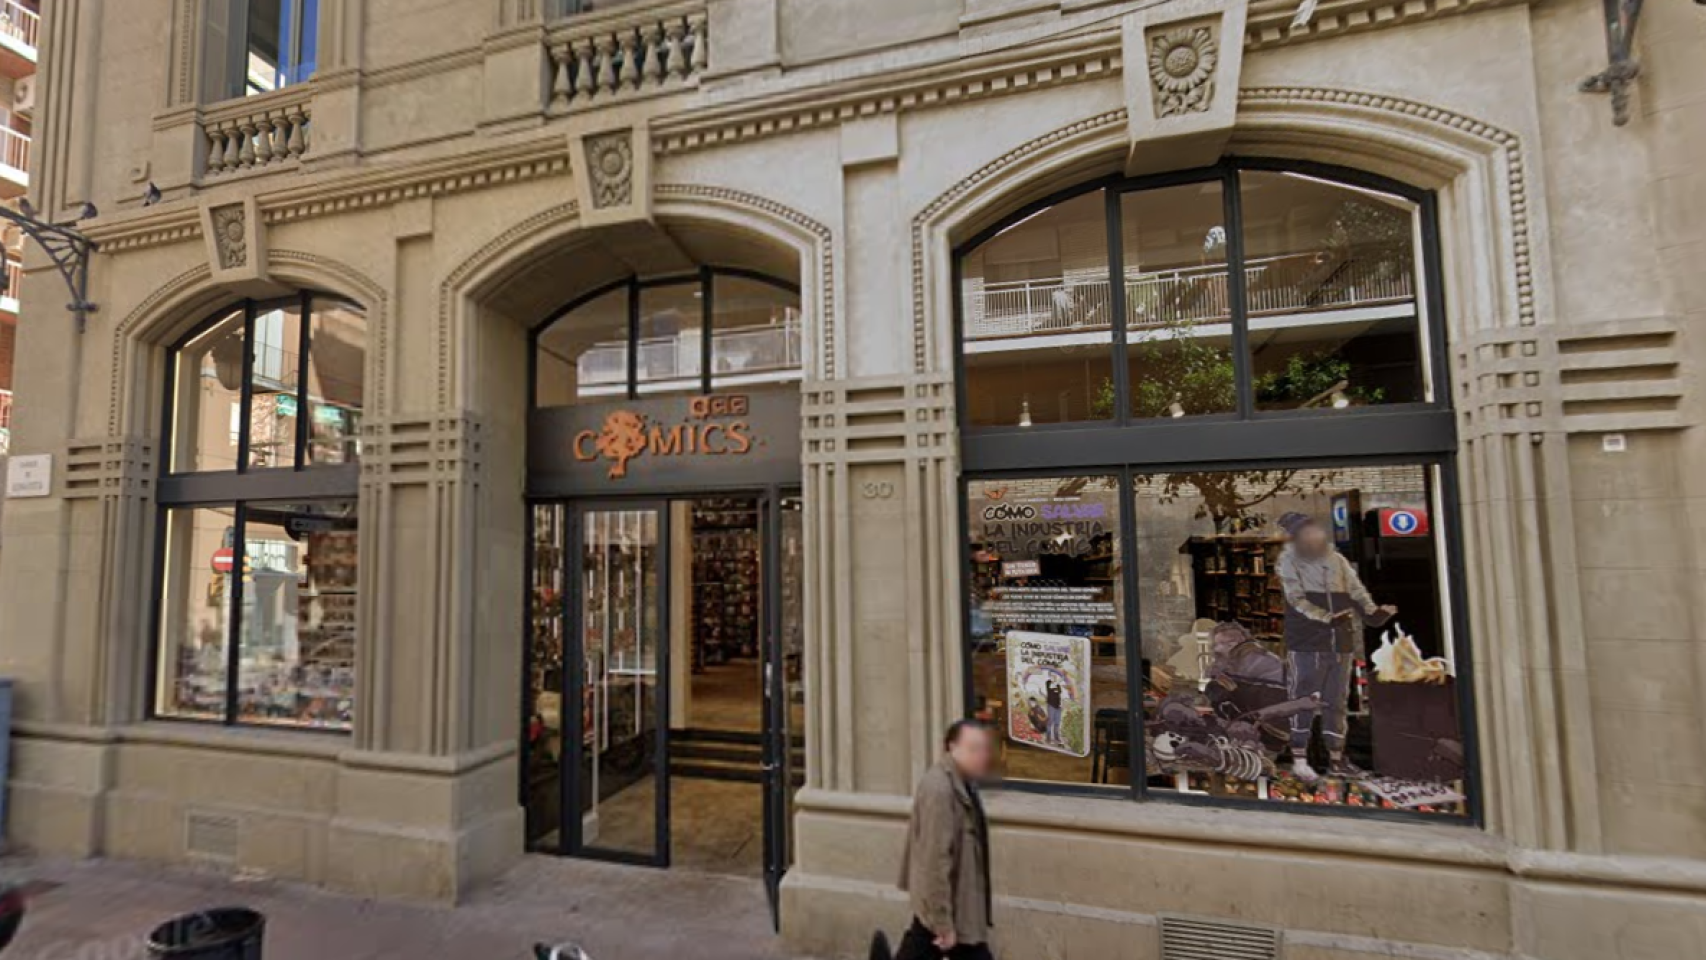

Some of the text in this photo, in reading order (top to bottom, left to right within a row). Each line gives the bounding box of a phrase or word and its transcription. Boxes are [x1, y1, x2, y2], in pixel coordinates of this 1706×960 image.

[862, 481, 895, 500] 30
[984, 520, 1105, 539] LA INDUSTRIA
